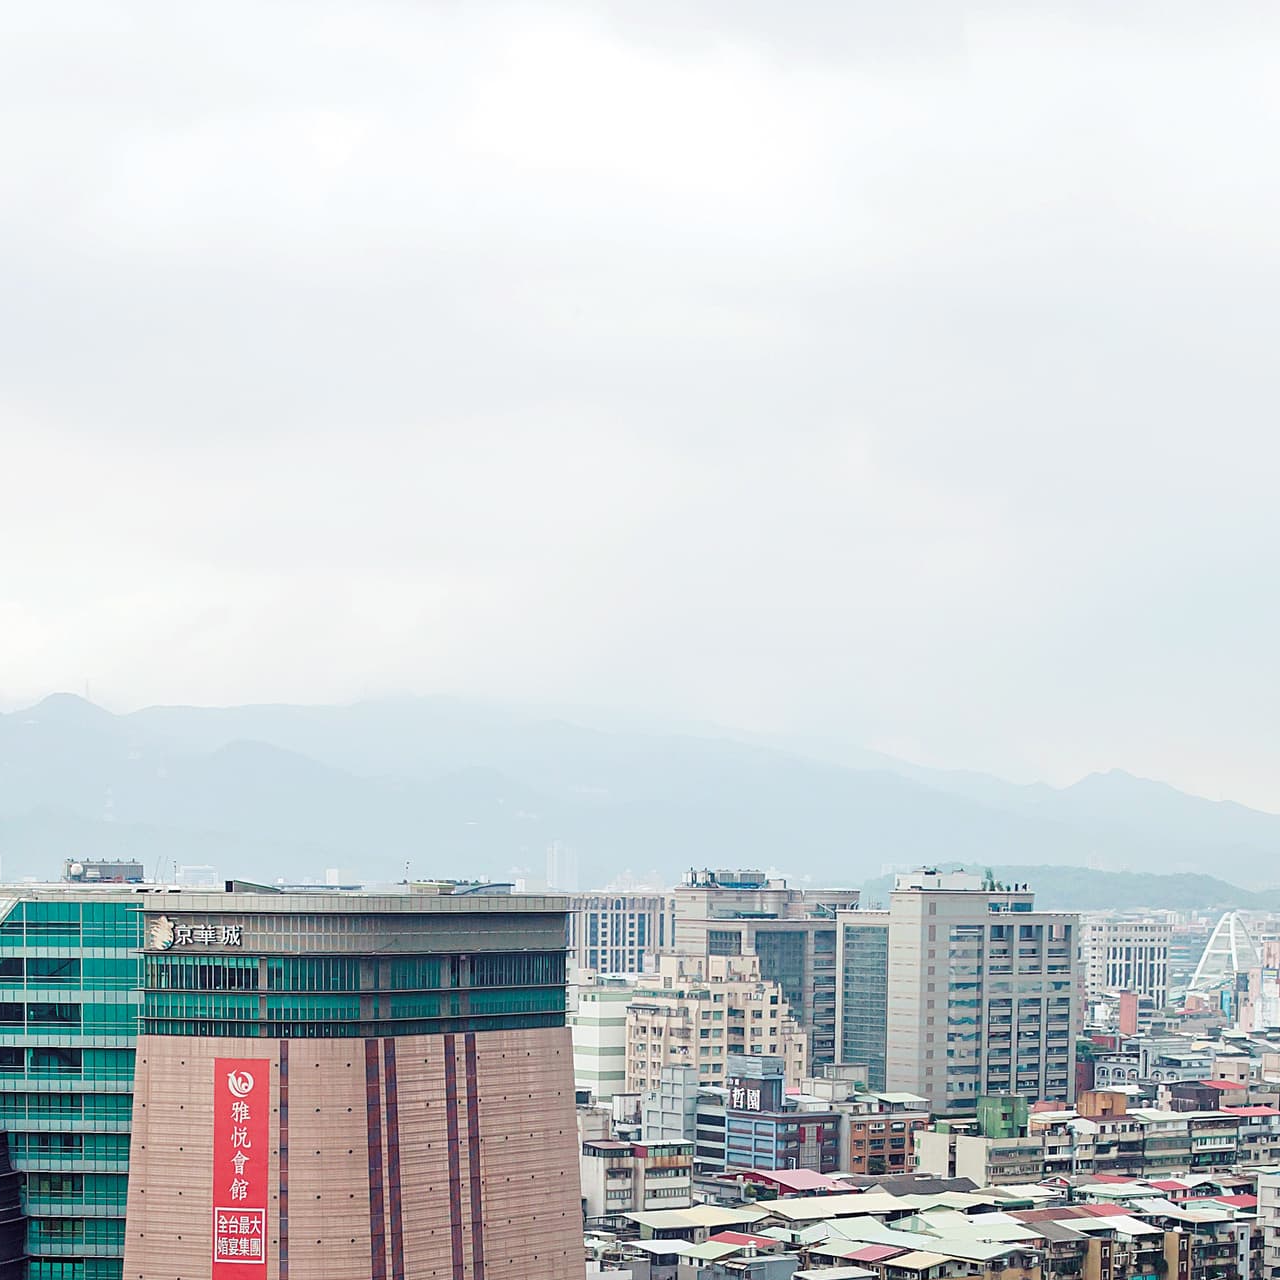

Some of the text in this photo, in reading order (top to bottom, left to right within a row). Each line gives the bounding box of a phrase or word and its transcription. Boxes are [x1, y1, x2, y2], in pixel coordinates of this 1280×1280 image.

[175, 924, 242, 946] 京華城
[218, 1216, 262, 1235] 全台最大
[218, 1237, 261, 1256] 婚宴集團
